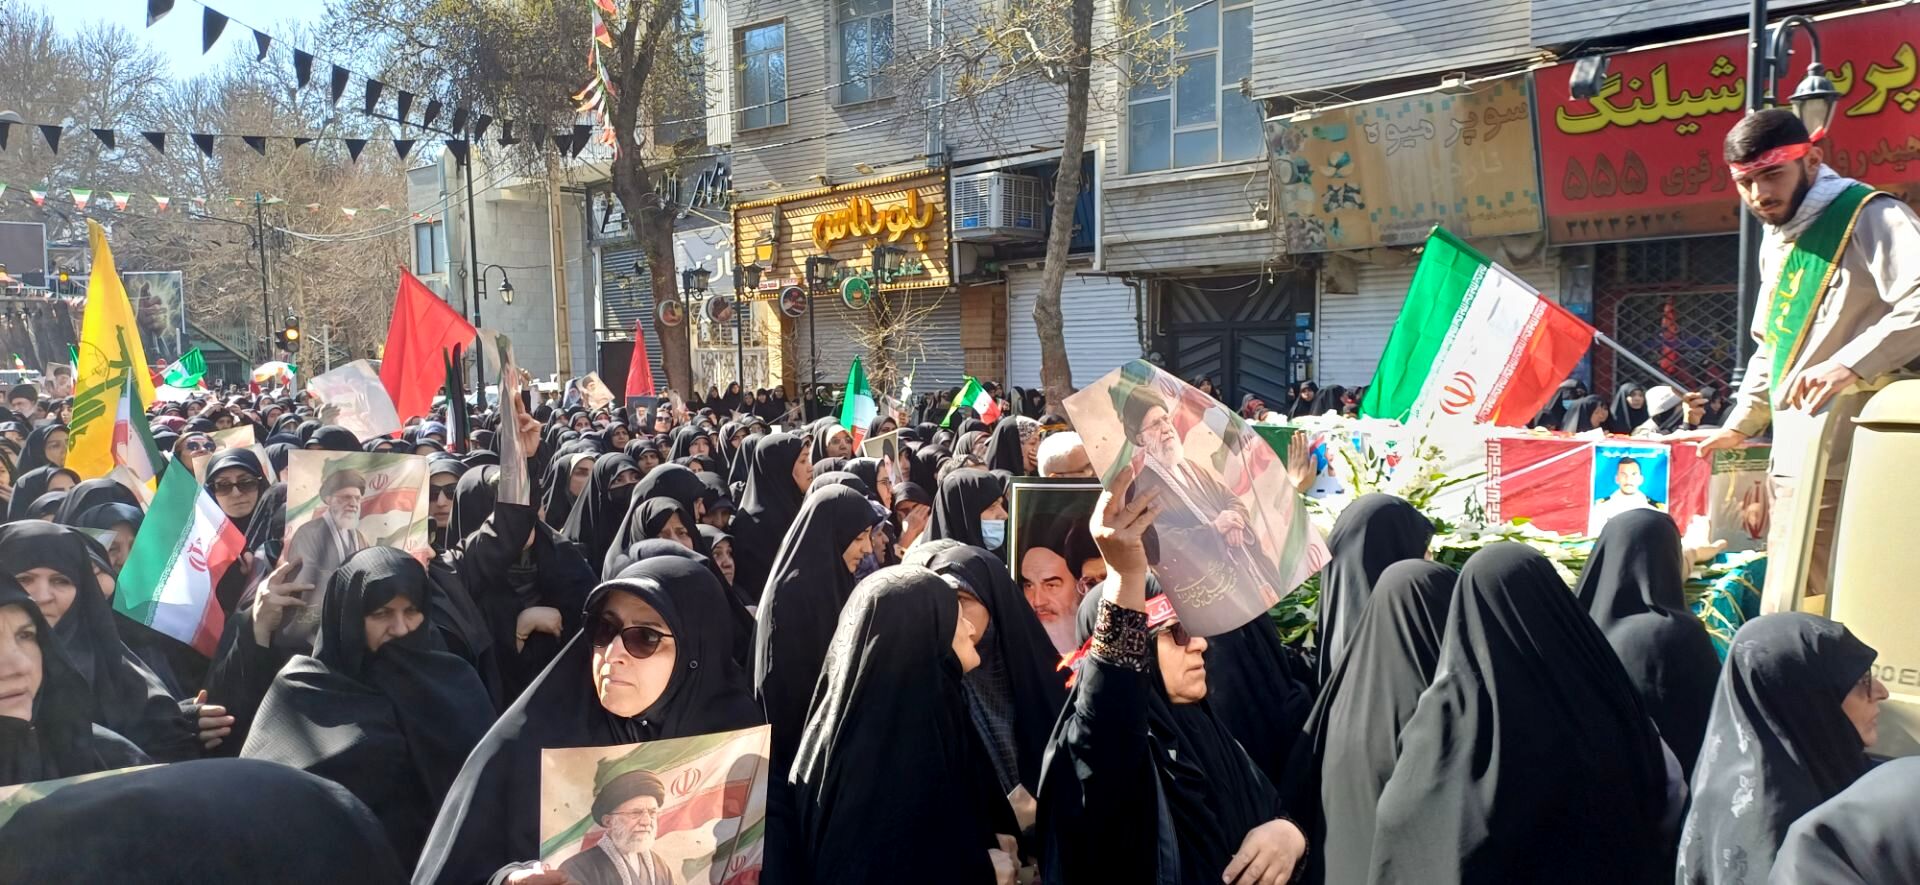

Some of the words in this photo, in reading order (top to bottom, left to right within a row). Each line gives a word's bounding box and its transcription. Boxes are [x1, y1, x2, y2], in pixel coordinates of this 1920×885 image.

[1554, 54, 1746, 137] شیلنگ
[1363, 118, 1436, 157] میوه
[1443, 101, 1529, 148] سوپر
[1561, 148, 1649, 201] ۵۵۵
